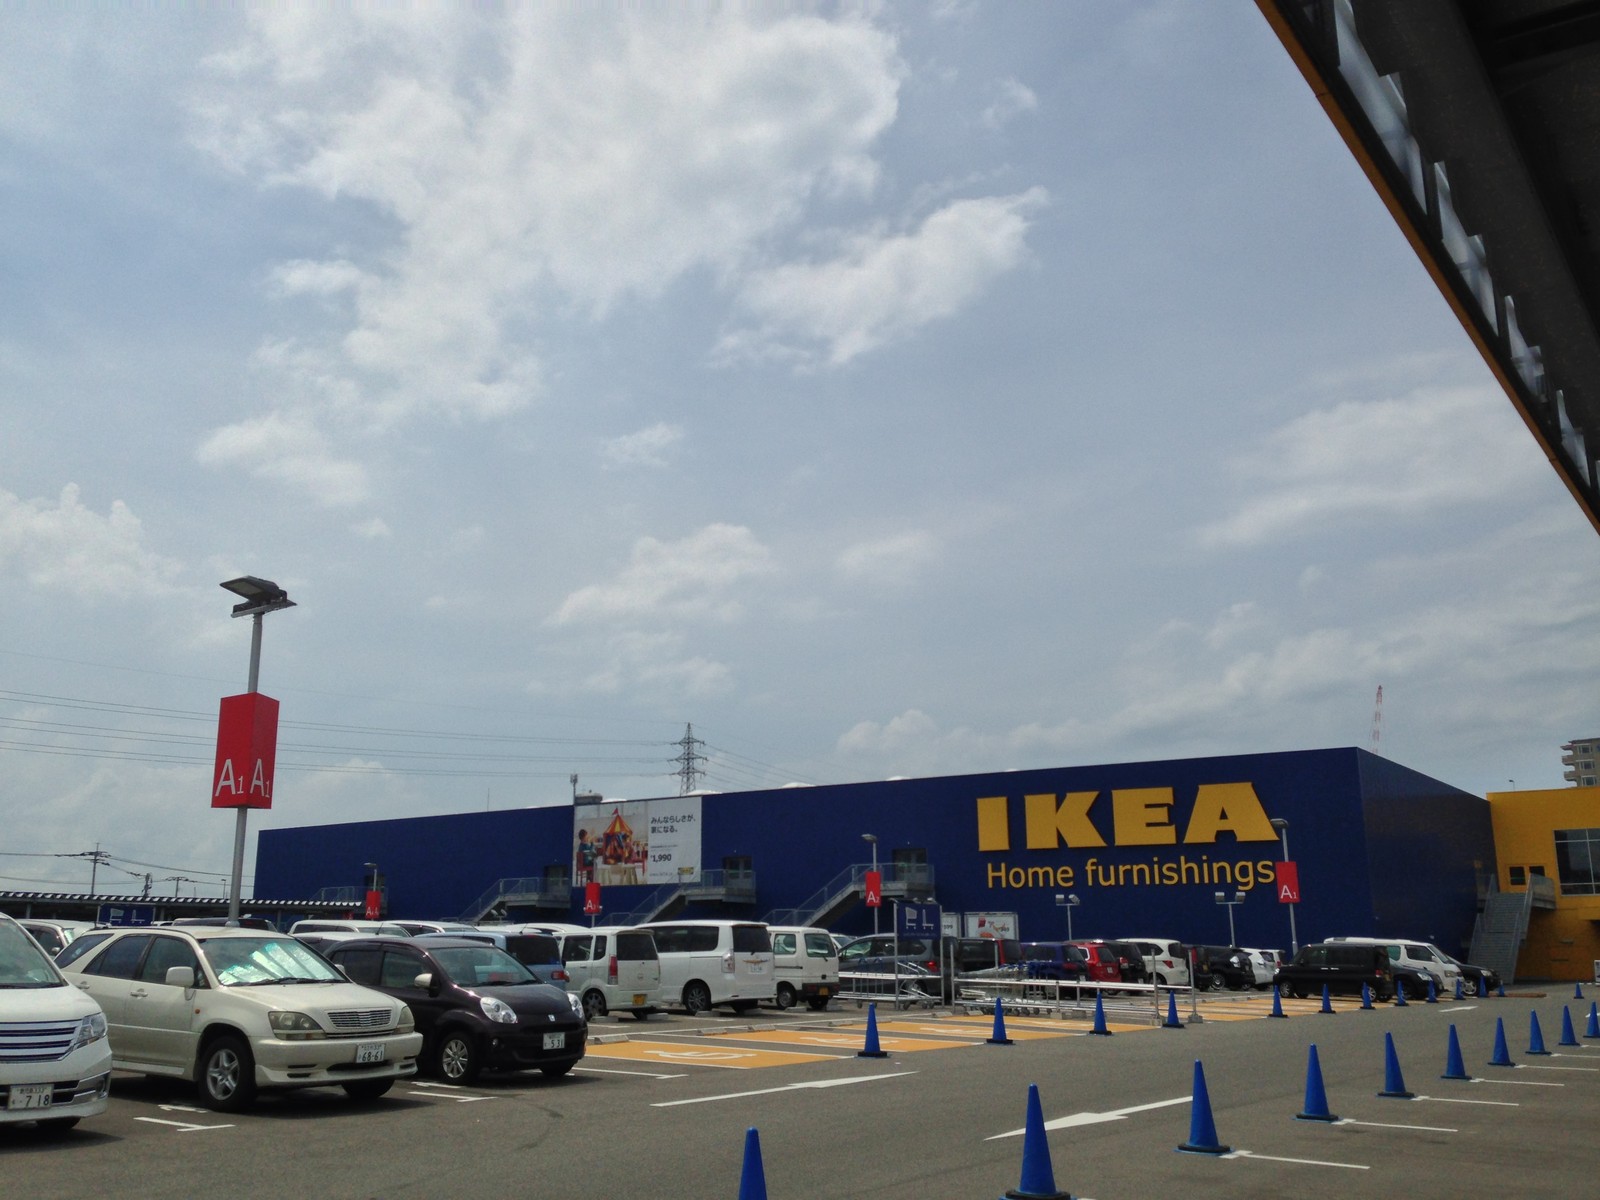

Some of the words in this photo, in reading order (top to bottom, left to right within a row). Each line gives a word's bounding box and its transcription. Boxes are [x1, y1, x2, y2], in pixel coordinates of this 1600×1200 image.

[215, 758, 244, 797] A1
[249, 758, 271, 798] A1
[976, 781, 1280, 852] IKEA
[986, 862, 1074, 889] Home
[1085, 855, 1276, 891] furnishings
[1280, 884, 1297, 899] A1
